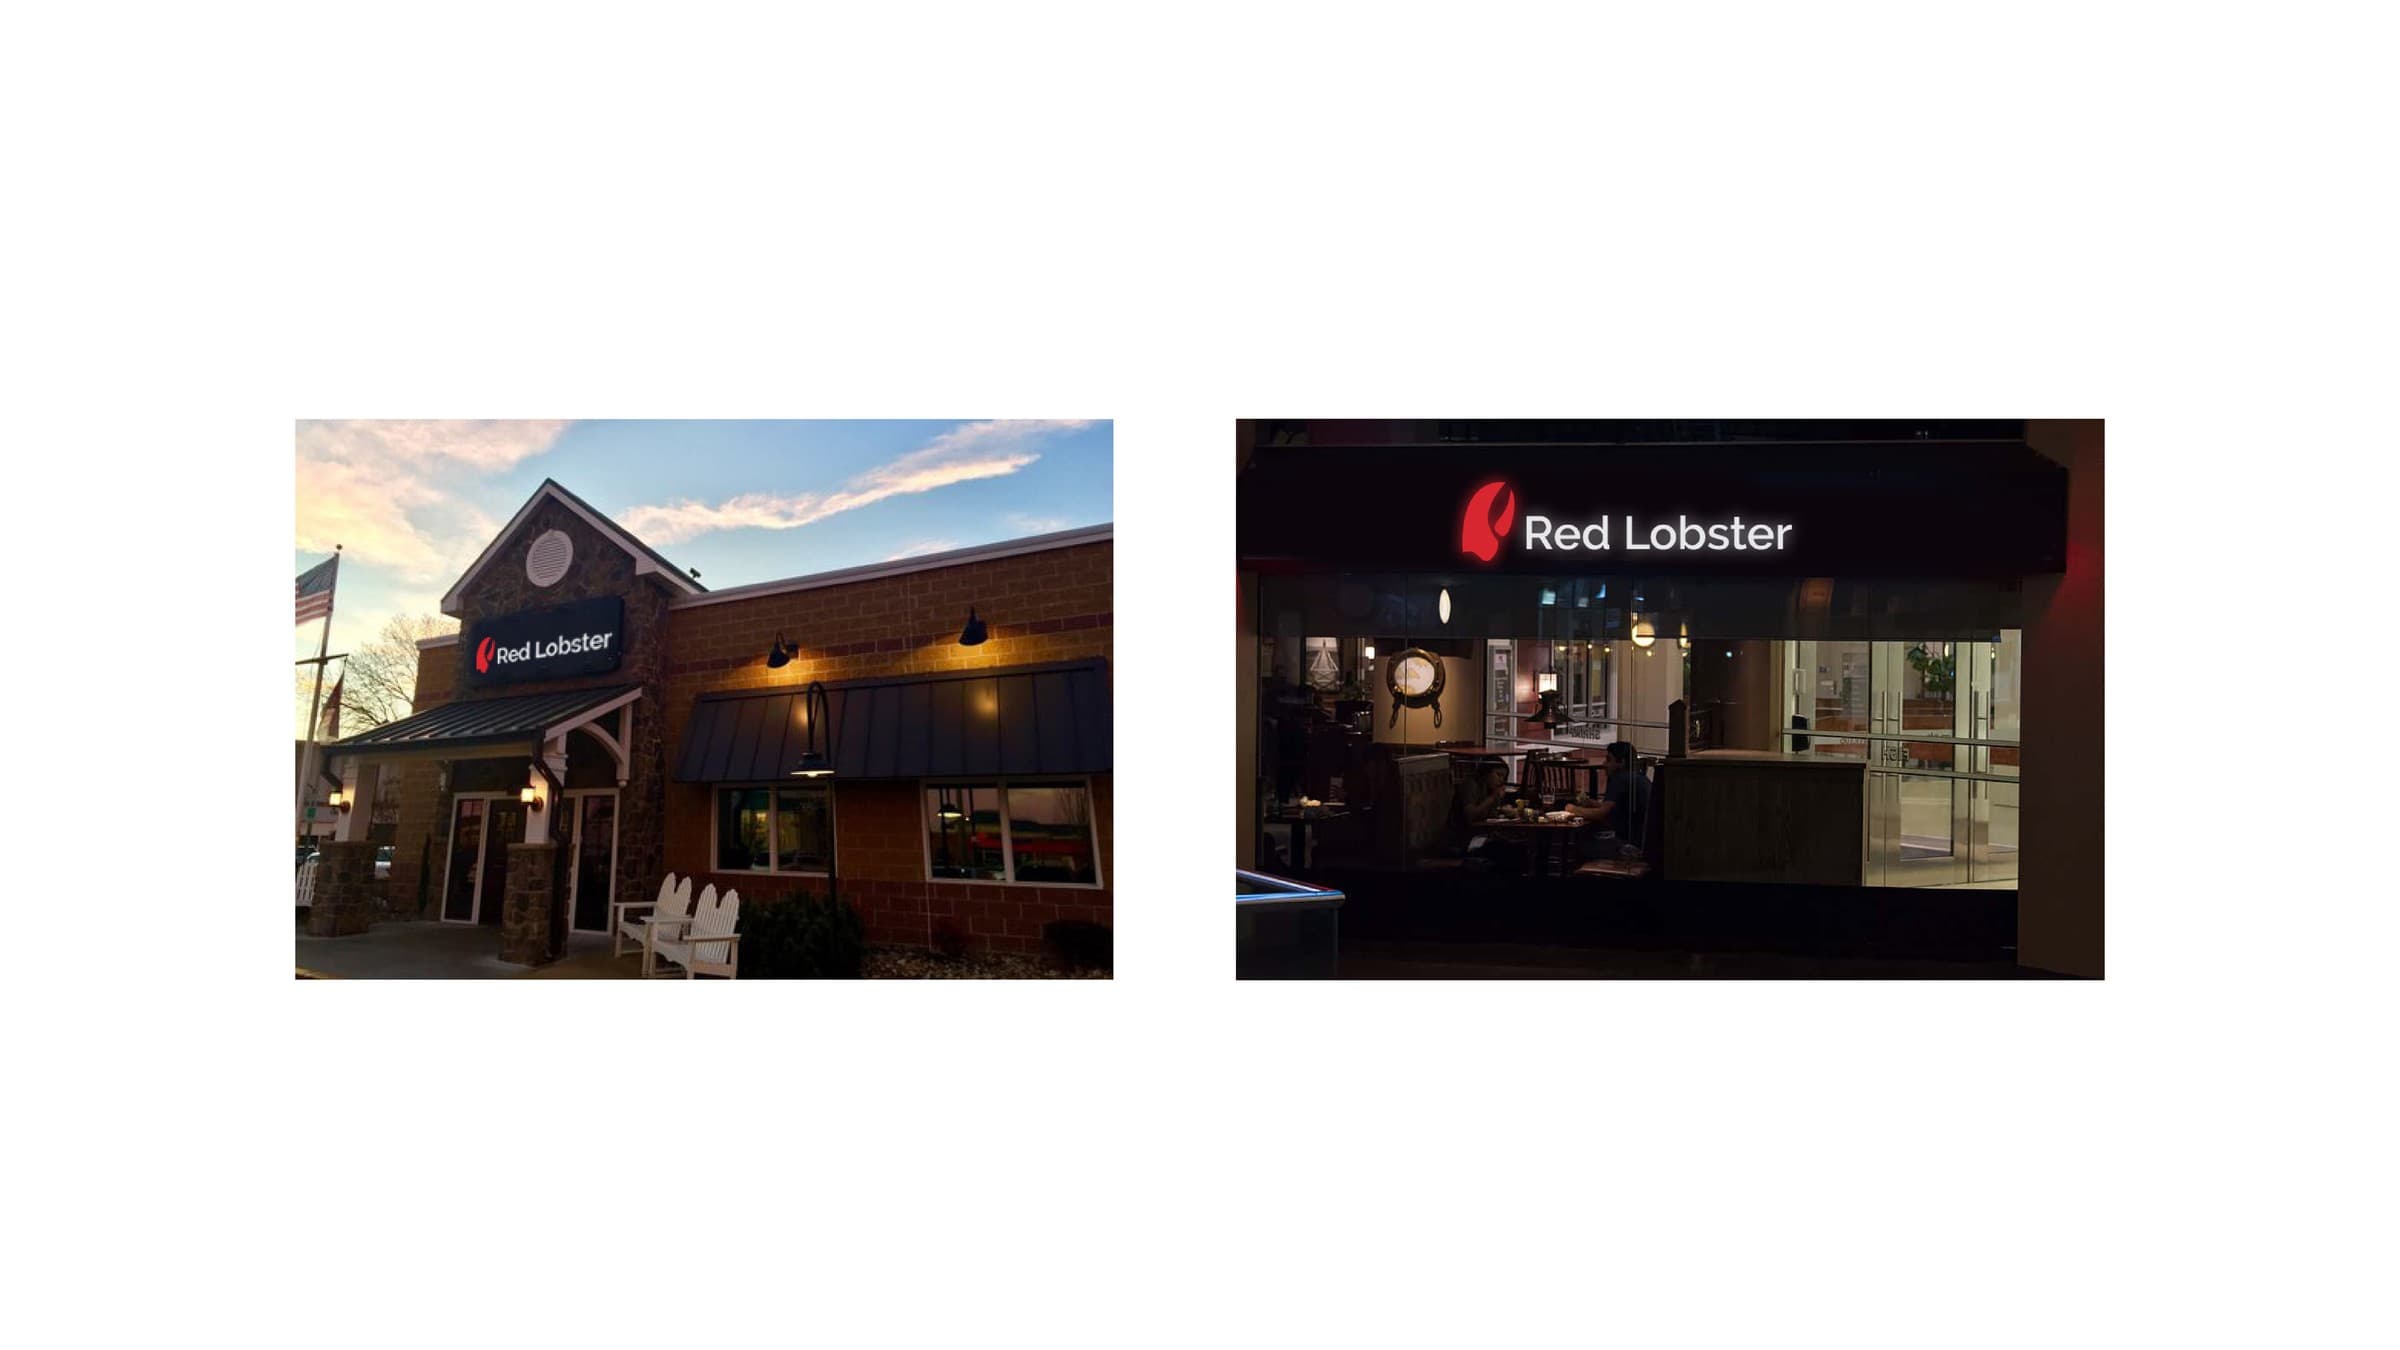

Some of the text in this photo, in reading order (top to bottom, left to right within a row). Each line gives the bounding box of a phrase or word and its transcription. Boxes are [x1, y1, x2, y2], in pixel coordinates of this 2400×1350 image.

[1525, 515, 1793, 551] Red Lobster
[497, 632, 612, 665] Red Lobster
